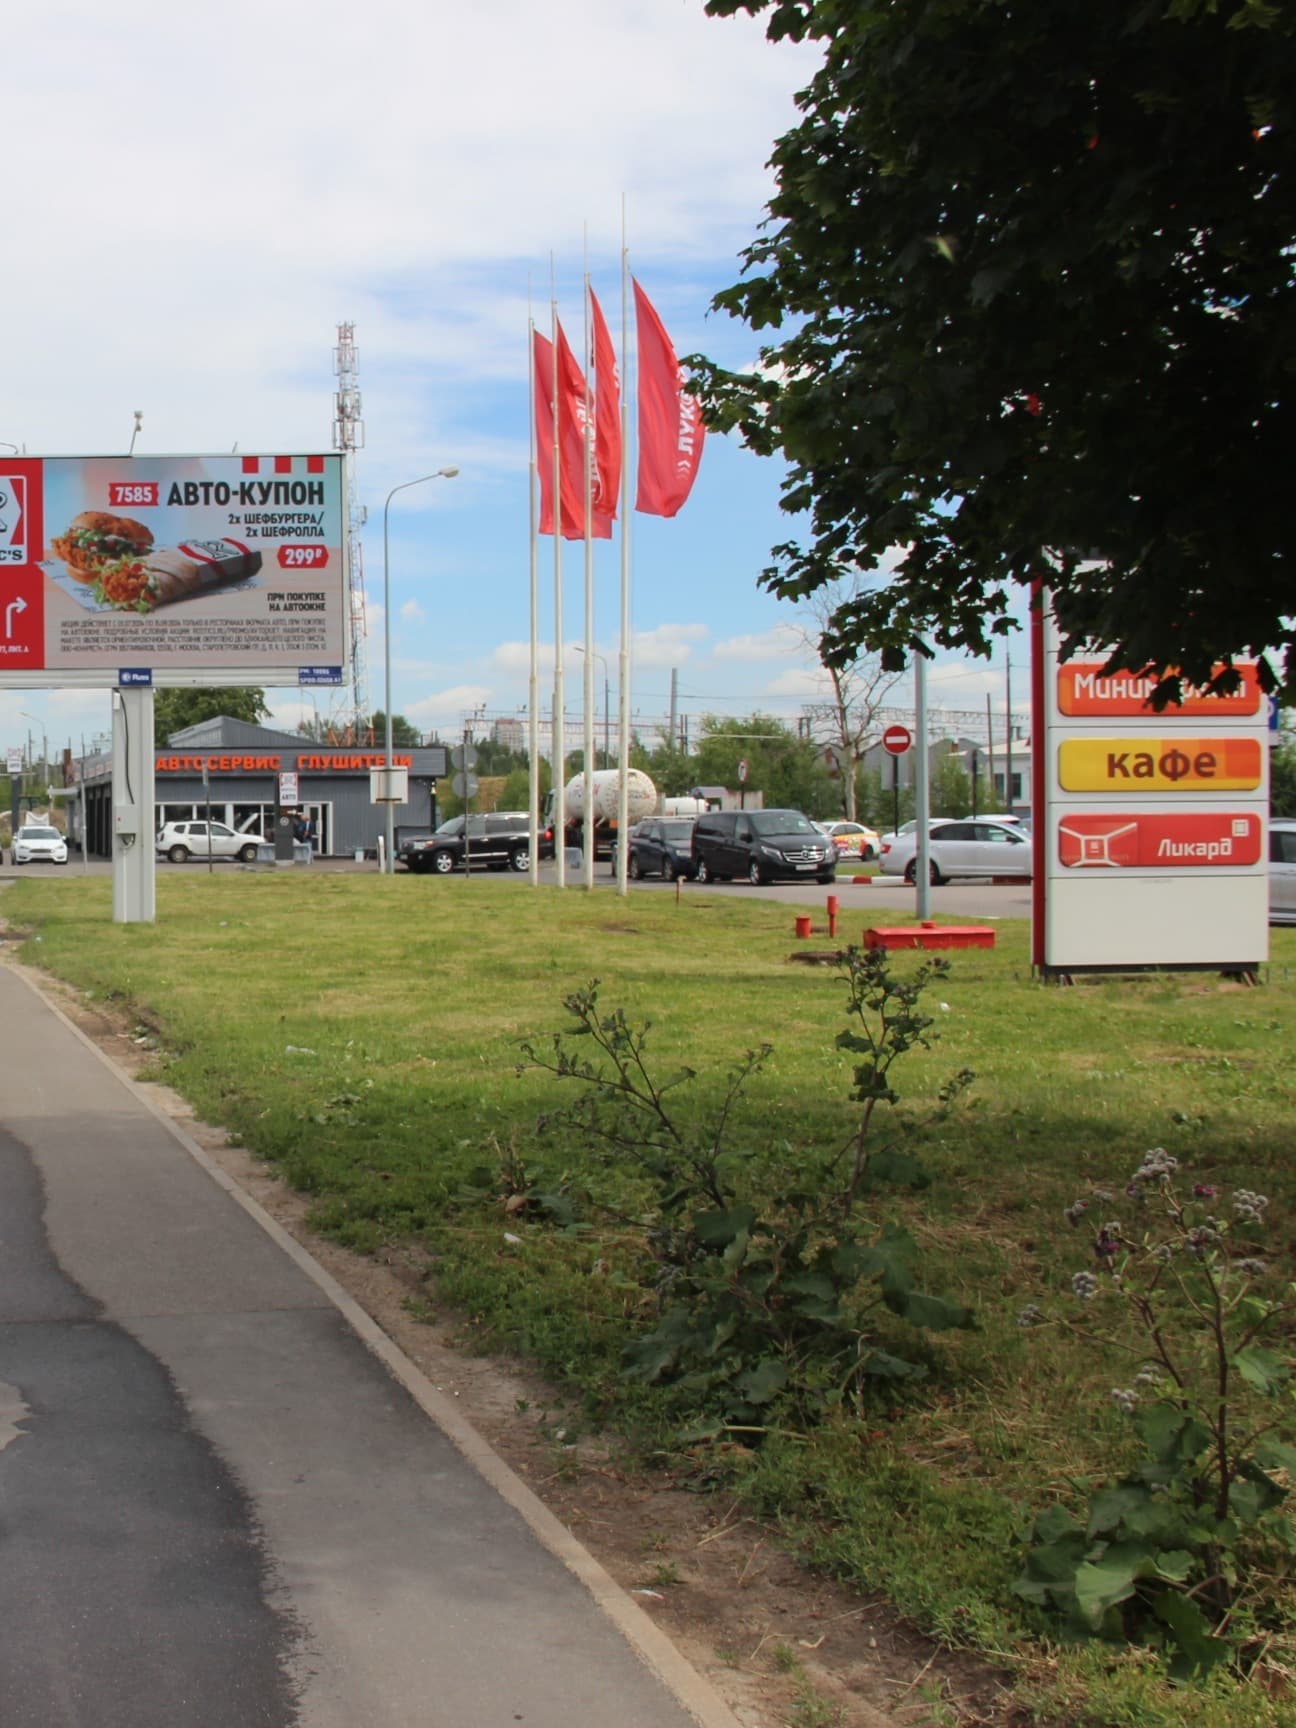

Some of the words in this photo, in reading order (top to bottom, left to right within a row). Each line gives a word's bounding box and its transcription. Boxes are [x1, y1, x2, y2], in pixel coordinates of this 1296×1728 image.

[115, 486, 153, 502] 7585
[167, 481, 325, 506] АВТО-КУПОН
[261, 526, 325, 537] ШЕФРОЛЛА
[267, 592, 285, 601] ПРИ
[287, 592, 326, 601] ПОКУПКЕ
[269, 603, 280, 611] НА
[283, 603, 326, 611] АВТООКНЕ
[156, 754, 281, 770] АВТОСЕРВИС
[1108, 749, 1217, 782] кафе
[1157, 838, 1232, 860] Ликард
